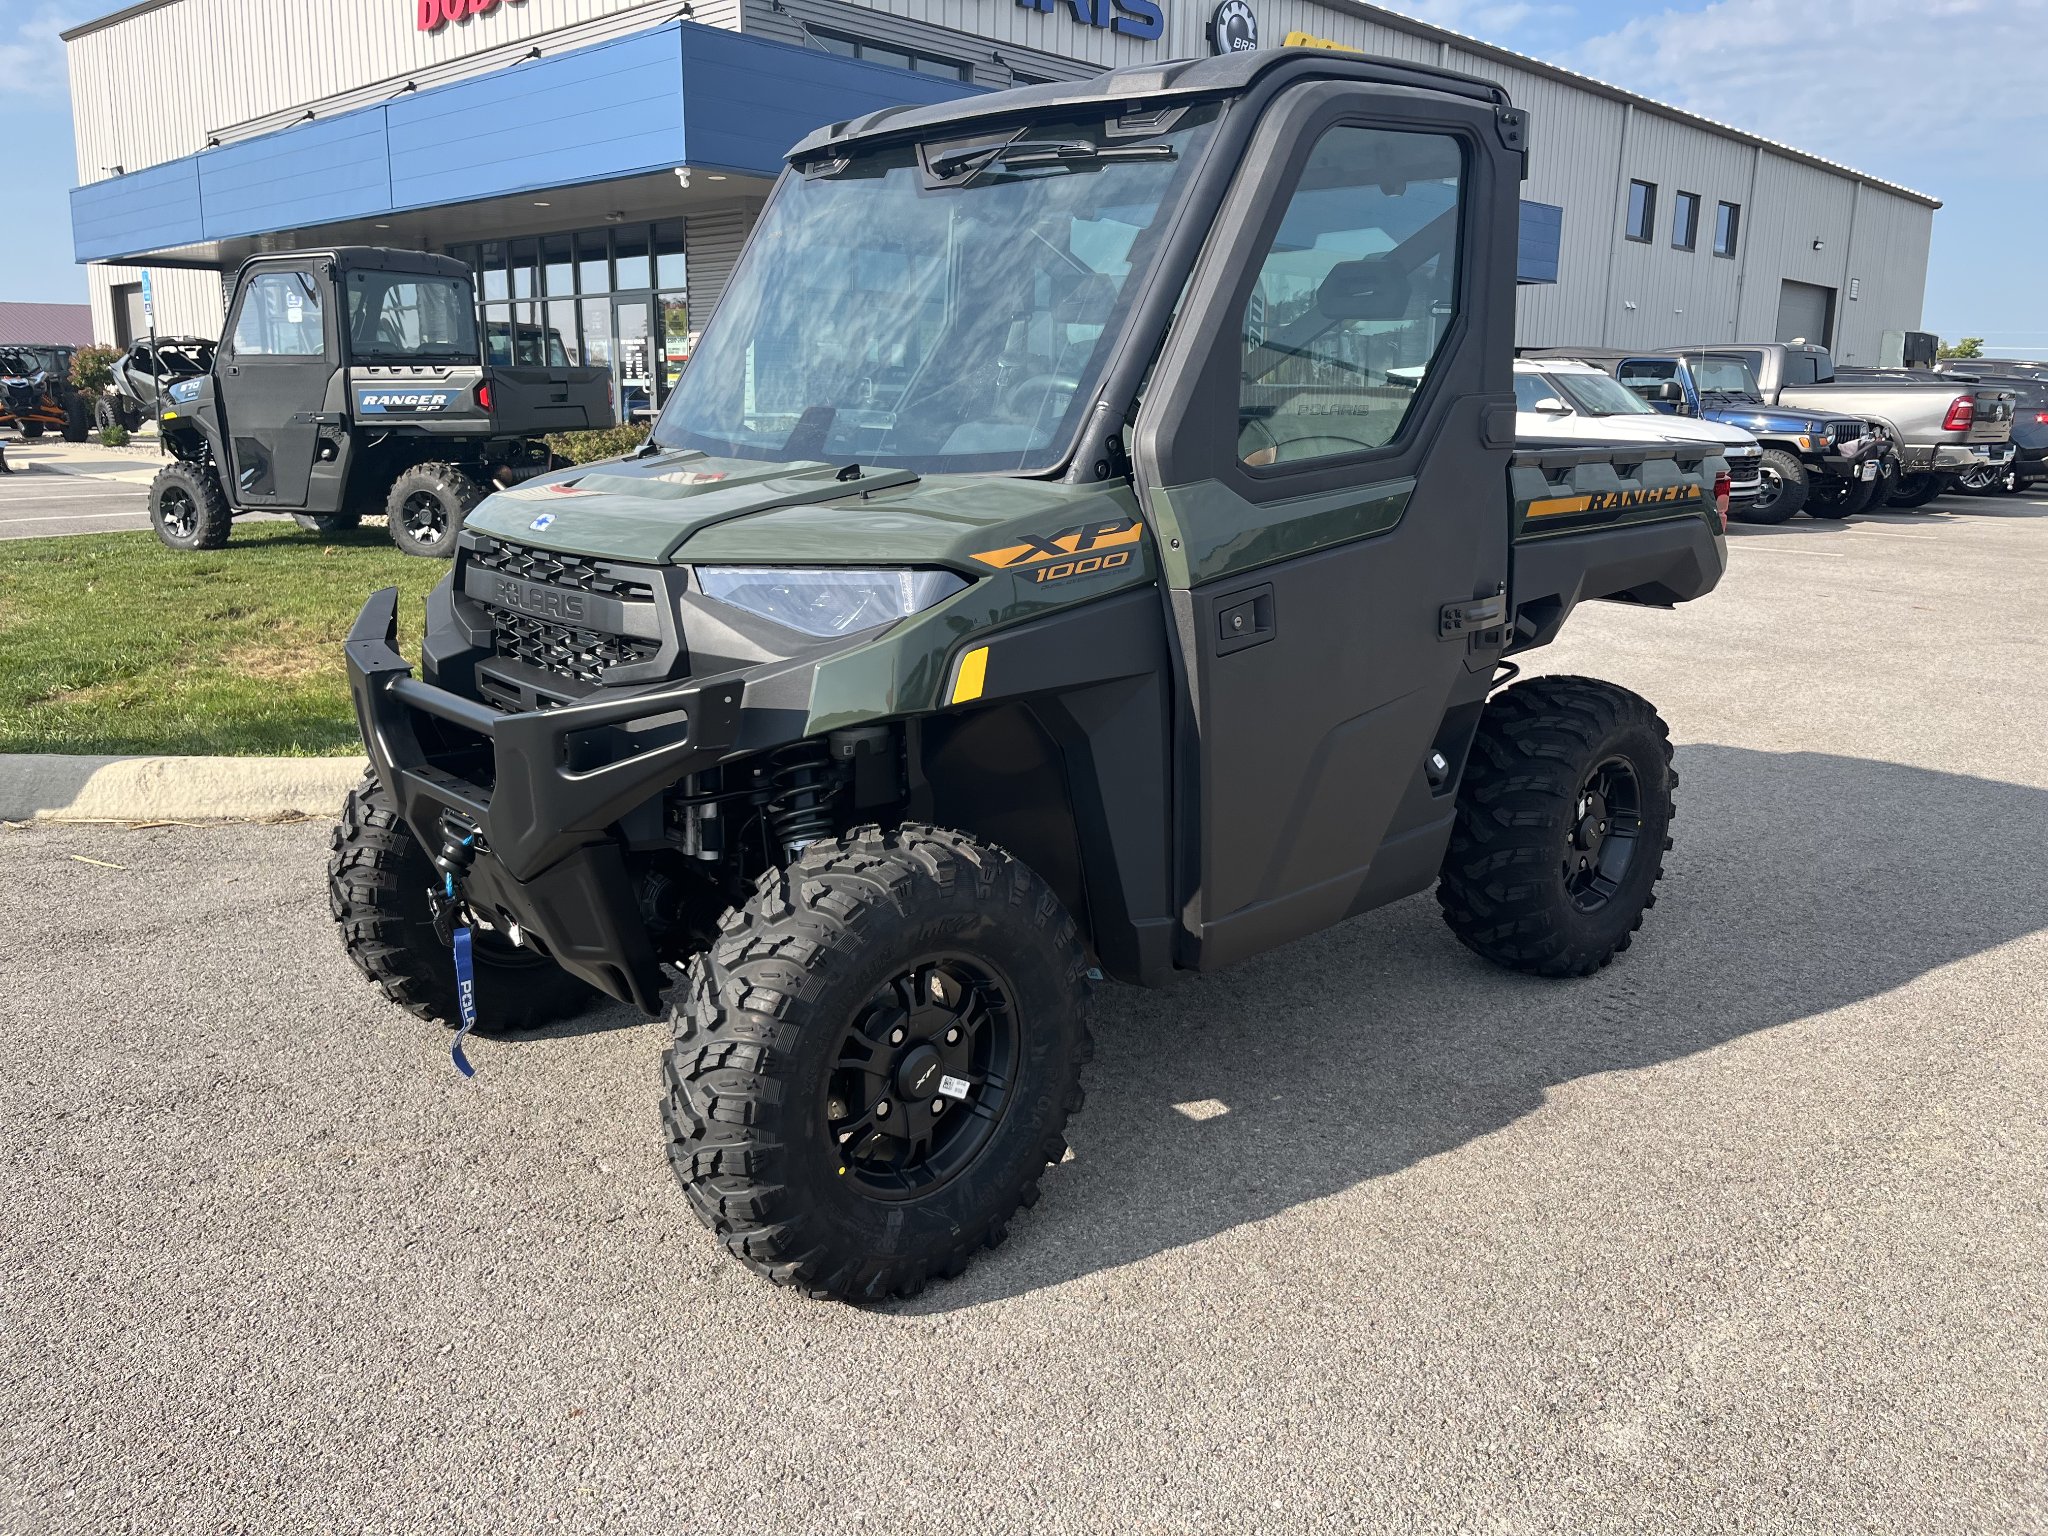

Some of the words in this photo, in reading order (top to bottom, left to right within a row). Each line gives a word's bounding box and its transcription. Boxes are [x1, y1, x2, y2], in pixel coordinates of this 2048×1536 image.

[362, 394, 447, 406] RANGER
[1298, 403, 1369, 416] POLARIS
[1587, 484, 1694, 512] RANGER
[1003, 516, 1138, 566] XP
[1036, 551, 1129, 583] 1000
[495, 578, 584, 621] POLARIS
